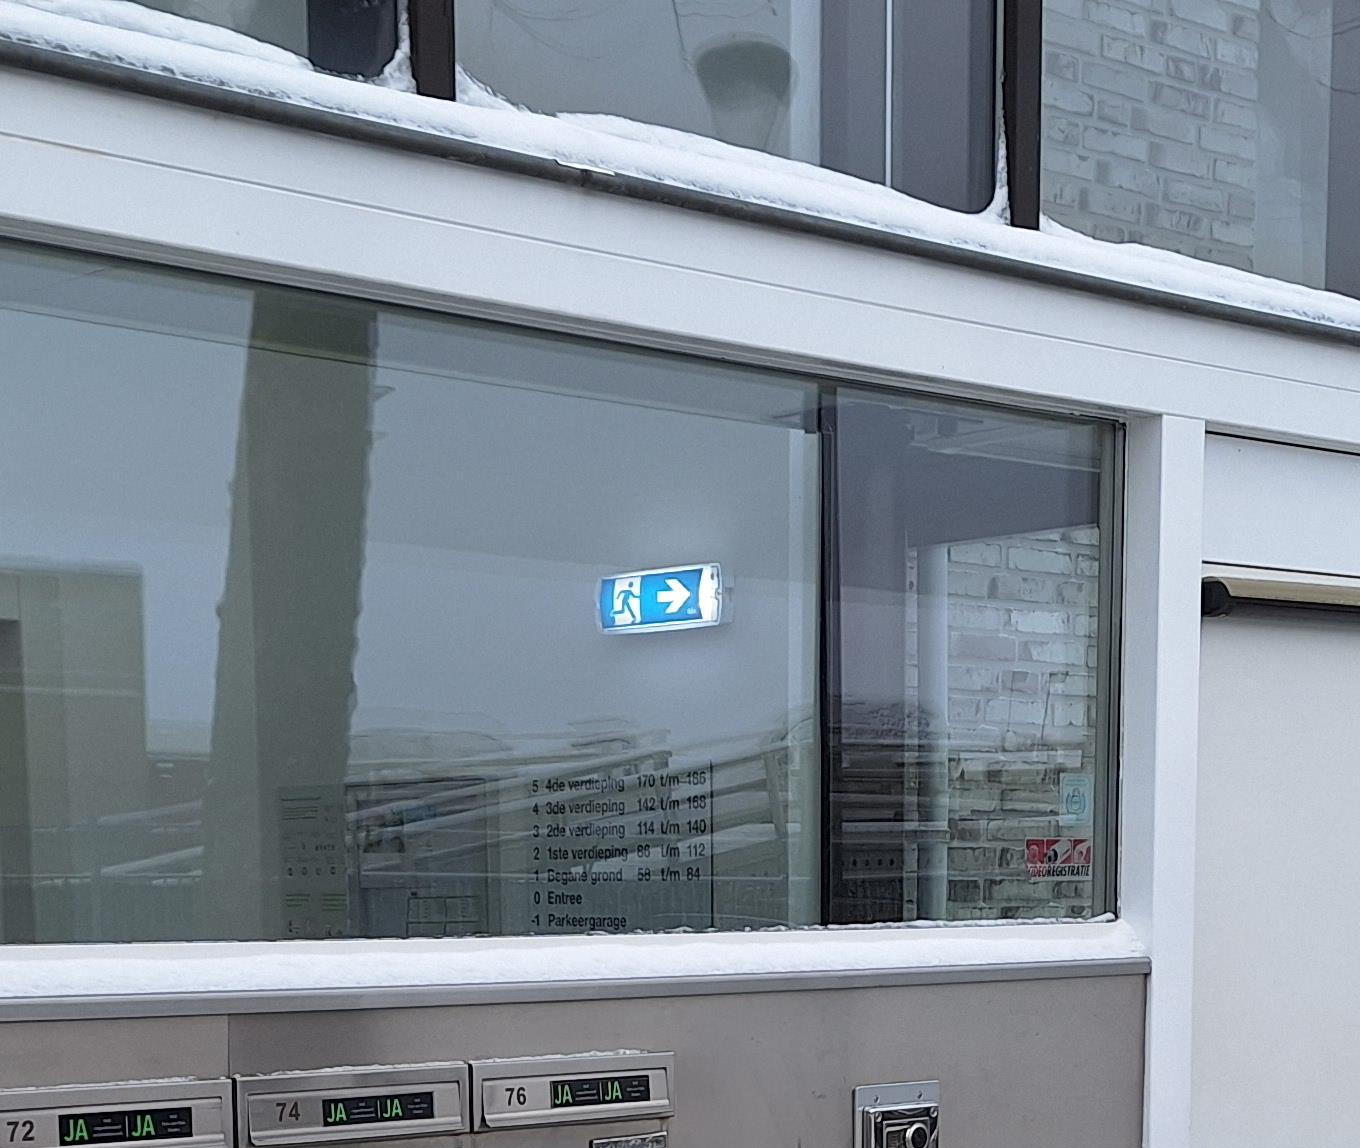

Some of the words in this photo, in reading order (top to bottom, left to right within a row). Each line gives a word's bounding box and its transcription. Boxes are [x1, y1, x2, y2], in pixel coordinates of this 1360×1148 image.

[532, 780, 539, 792] 5
[545, 778, 565, 792] 4de
[637, 774, 656, 788] 170
[660, 774, 680, 787] t/m
[532, 803, 539, 815] 4
[545, 801, 566, 815] 3de
[637, 797, 656, 811] 142
[660, 798, 680, 811] t/m
[533, 825, 539, 837] 3
[546, 823, 566, 837] 2de
[637, 821, 655, 835] 114
[660, 819, 680, 834] t/m
[687, 819, 706, 833] 140
[533, 847, 540, 861] 2
[548, 846, 570, 860] 1ste
[571, 844, 628, 862] verdieping
[687, 842, 706, 857] 112
[591, 867, 623, 885] grond
[661, 867, 680, 881] t/m
[687, 866, 701, 881] 84
[1028, 865, 1090, 877] IDEOREGISTRATIE
[534, 891, 540, 904] 0
[547, 890, 583, 905] Entree
[531, 913, 540, 927] -1
[548, 911, 627, 930] Parkeergarage
[504, 1086, 527, 1107] 76
[554, 1084, 573, 1105] JA
[604, 1080, 623, 1101] JA
[275, 1101, 301, 1122] 74
[327, 1102, 348, 1123] JA
[382, 1098, 403, 1118] JA
[6, 1120, 36, 1143] 72
[64, 1118, 89, 1142] JA
[131, 1114, 156, 1138] JA
